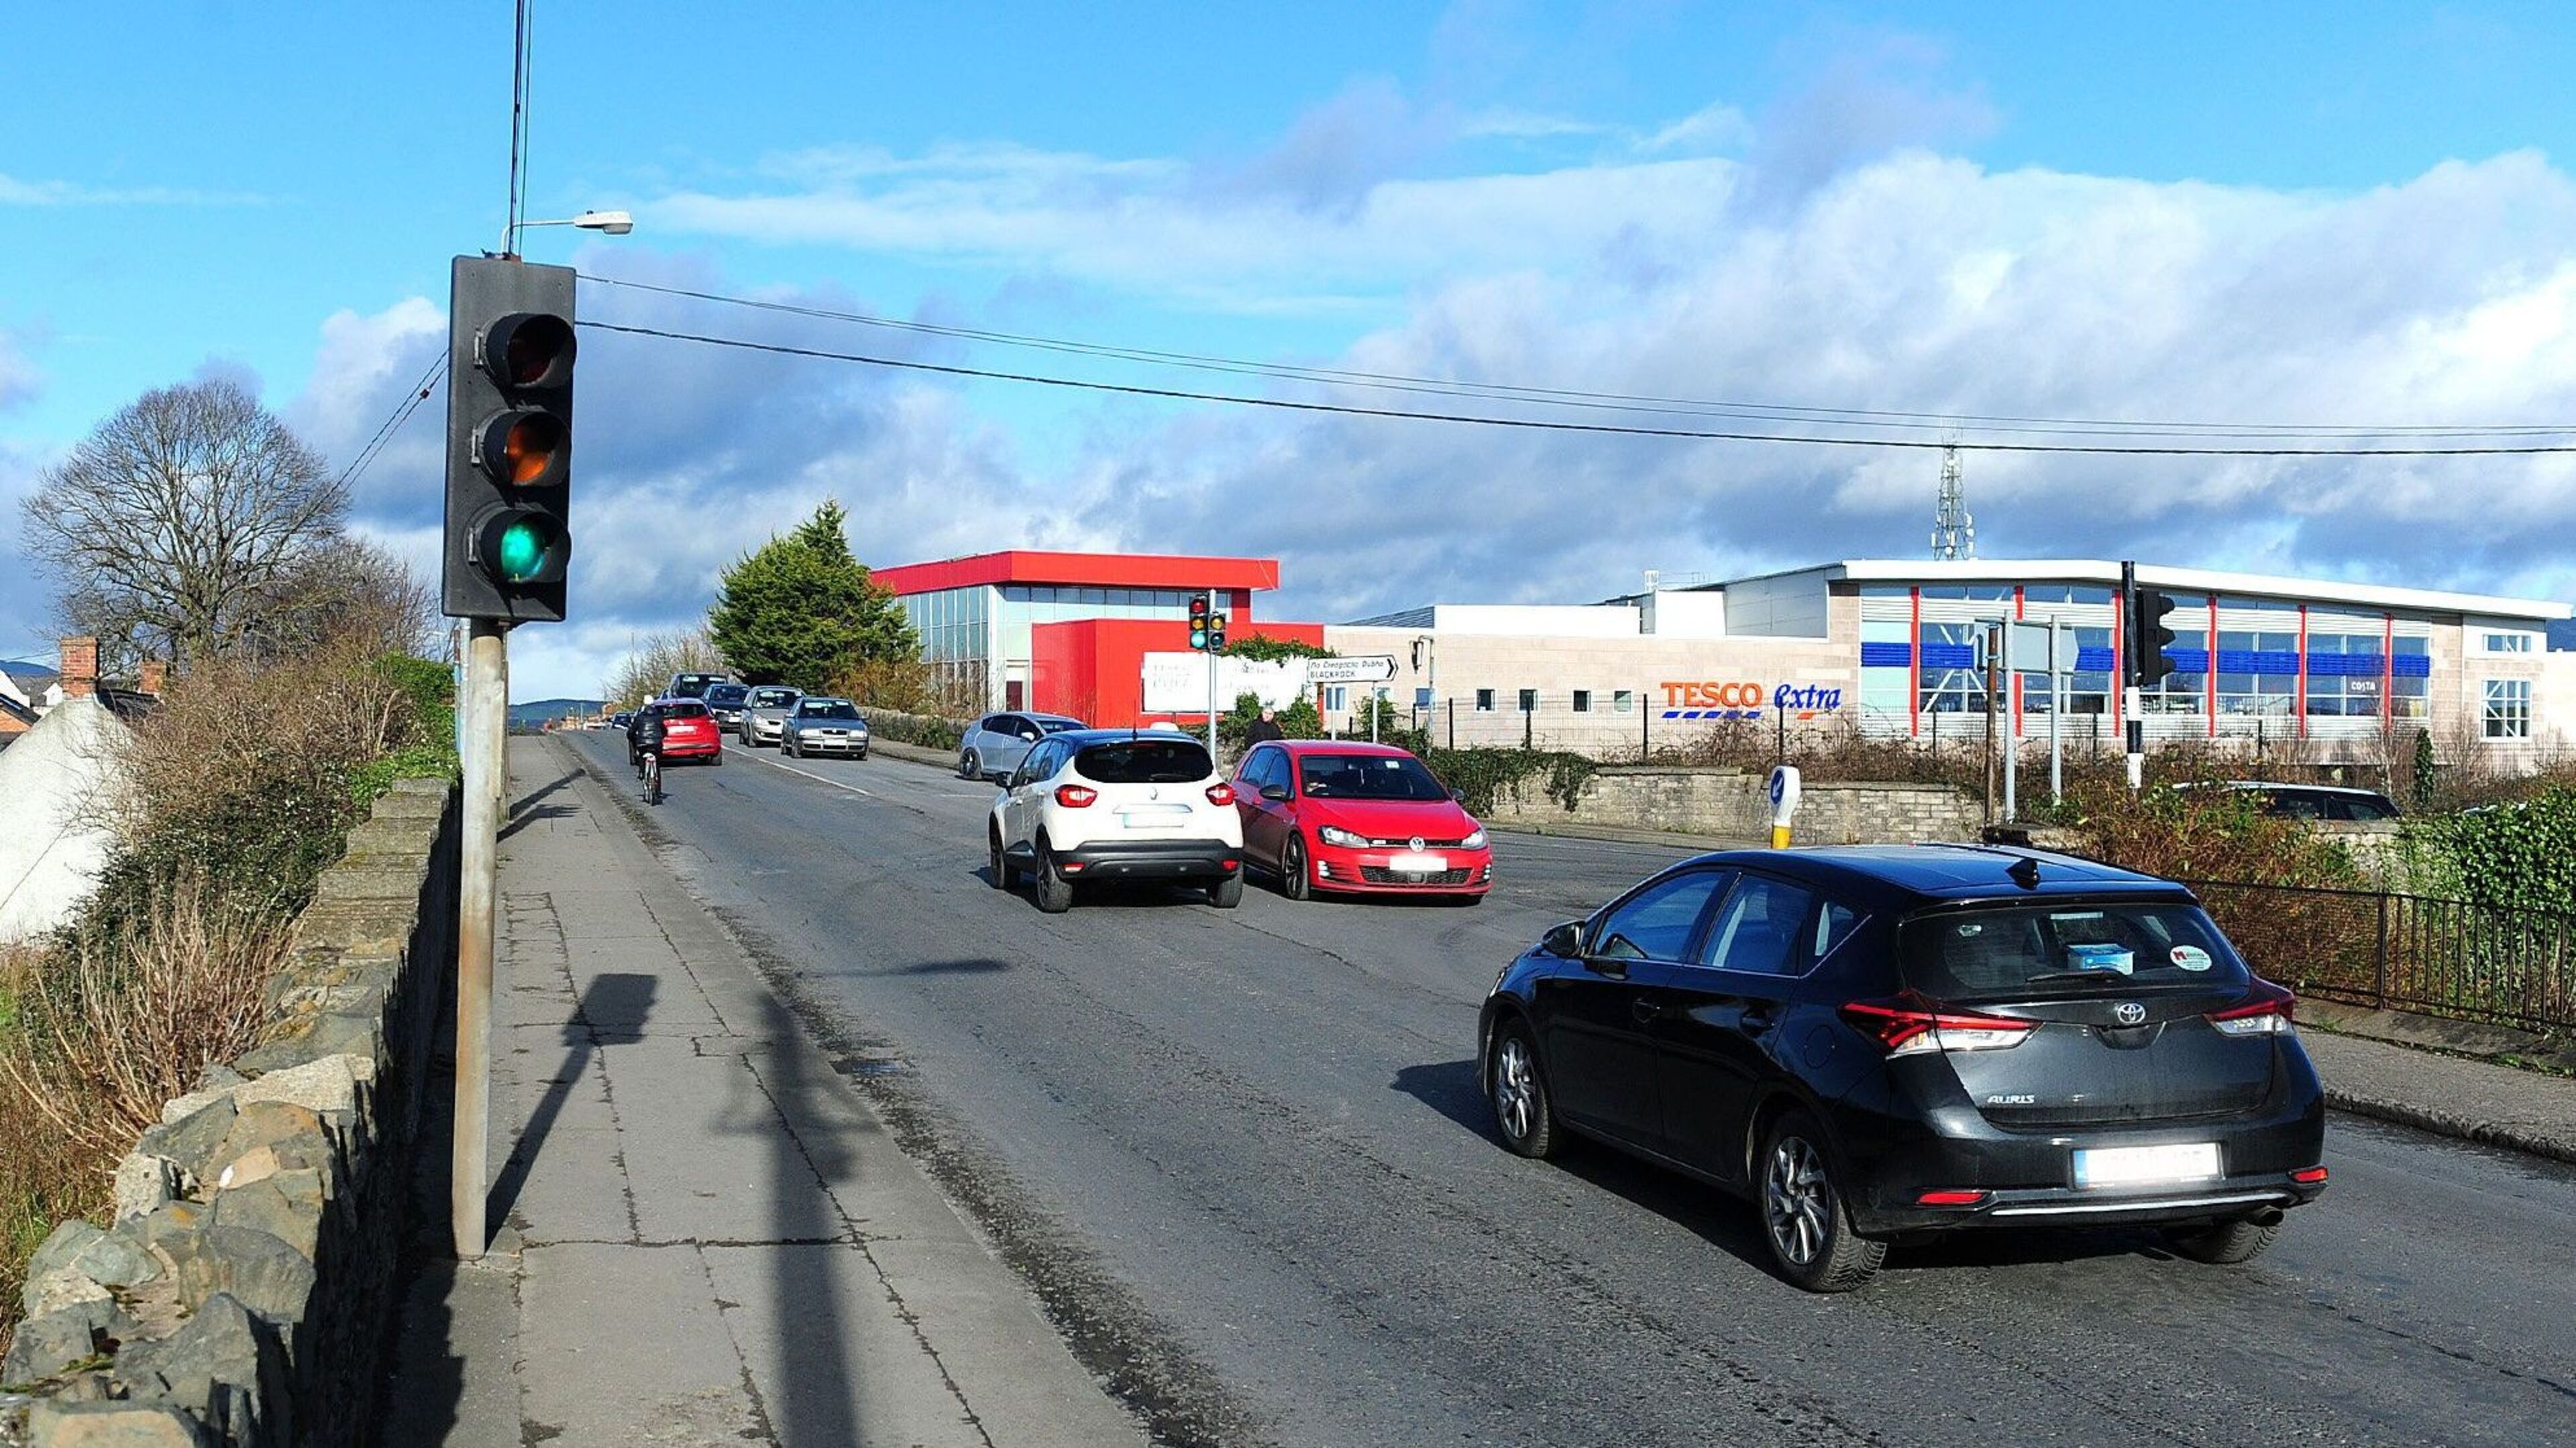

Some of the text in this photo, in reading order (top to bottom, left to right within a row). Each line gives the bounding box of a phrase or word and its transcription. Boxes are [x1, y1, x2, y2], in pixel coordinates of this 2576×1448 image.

[1309, 671, 1356, 679] BLACKROCK
[2351, 681, 2377, 691] COSTA
[1660, 682, 1842, 709] TESCO extra
[1987, 1095, 2035, 1104] AURIS
